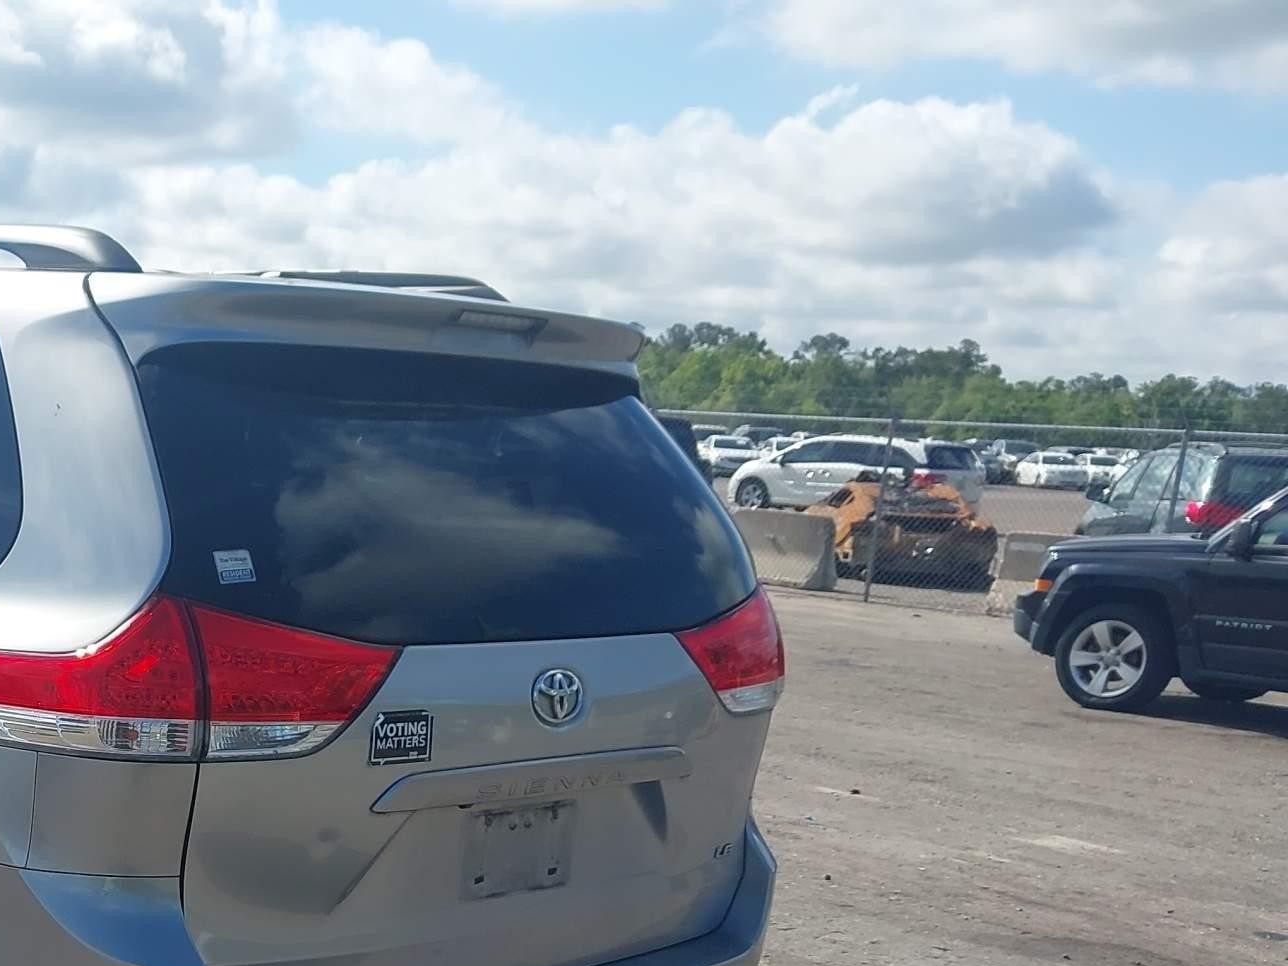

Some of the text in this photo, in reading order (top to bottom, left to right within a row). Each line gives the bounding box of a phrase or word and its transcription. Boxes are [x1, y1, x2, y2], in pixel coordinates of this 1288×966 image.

[1215, 620, 1273, 631] PATRIOT
[377, 721, 427, 738] VOTING
[376, 735, 426, 750] MATTERS
[475, 767, 625, 799] SIENNA
[713, 842, 734, 858] LE
